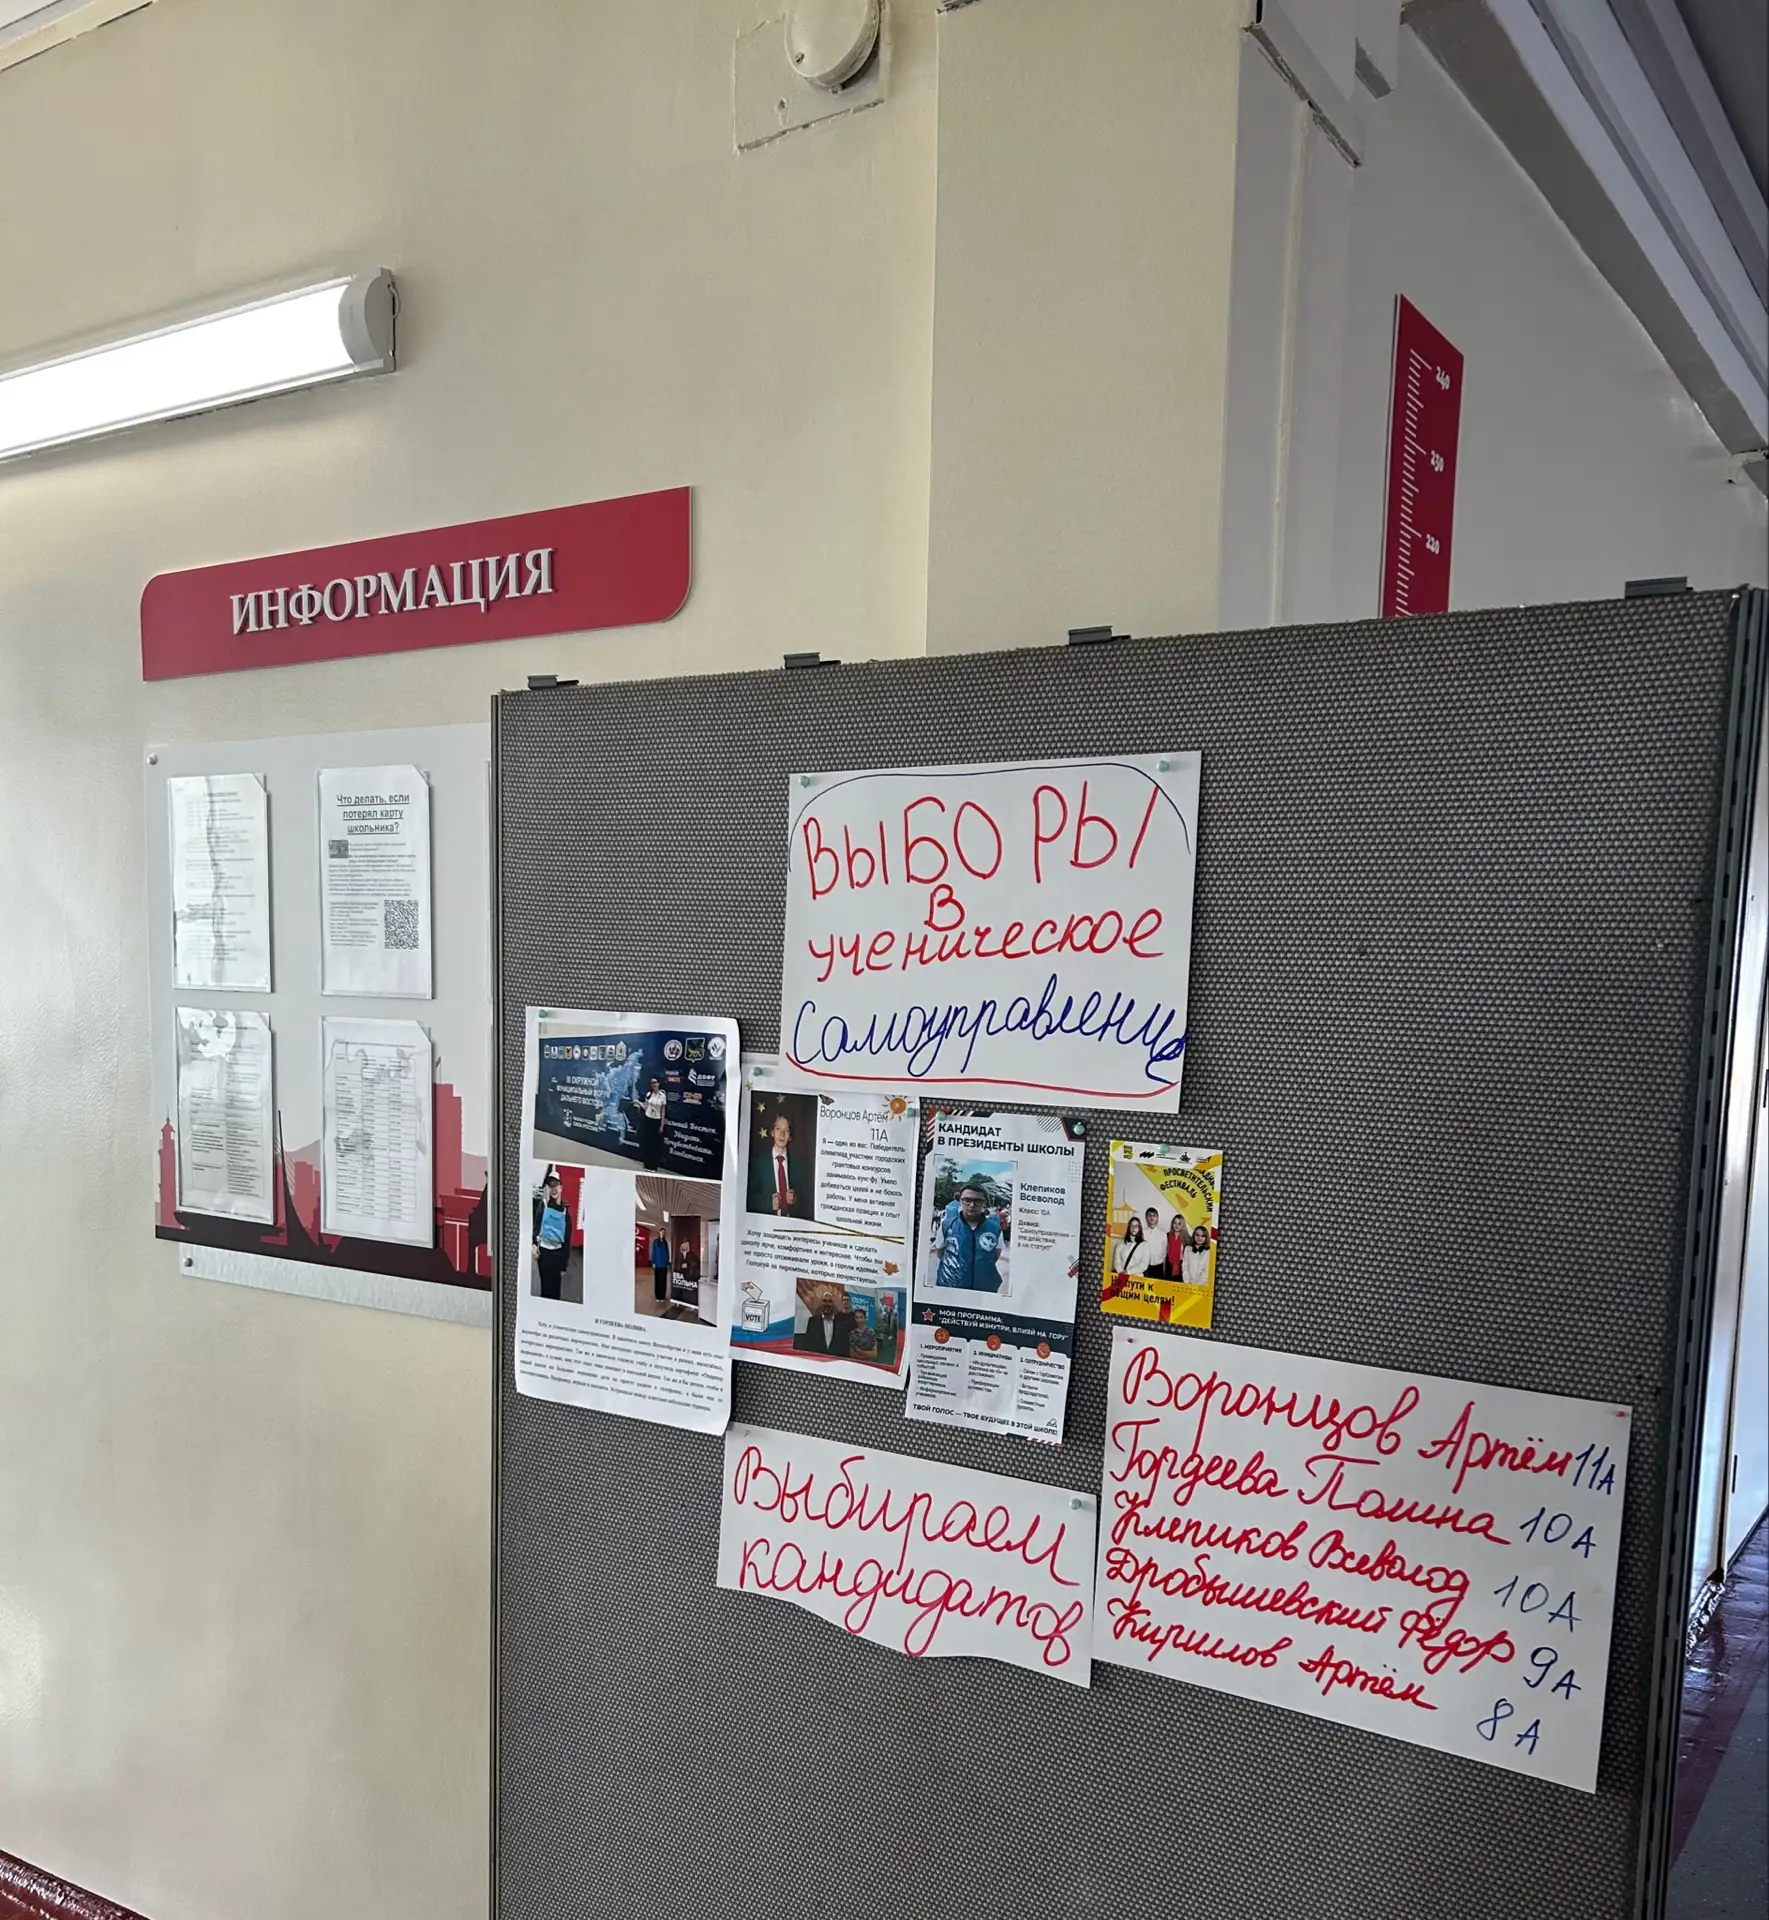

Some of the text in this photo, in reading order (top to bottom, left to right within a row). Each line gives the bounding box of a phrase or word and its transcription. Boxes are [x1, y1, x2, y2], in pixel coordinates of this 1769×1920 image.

[1436, 366, 1450, 390] 240
[1431, 450, 1445, 472] 230
[1425, 533, 1440, 554] 220
[229, 547, 556, 635] ИНФОРМАЦИЯ
[337, 793, 410, 804] Что делать, если
[343, 808, 404, 820] потерял карту
[347, 822, 400, 834] школьника?
[808, 908, 1164, 982] ученическое
[820, 1105, 888, 1124] Воронцов Артём
[870, 1128, 889, 1142] 11А
[938, 1123, 1001, 1137] КАНДИДАТ
[870, 1143, 906, 1153] Победитель
[937, 1136, 1074, 1156] В ПРЕЗИДЕНТЫ ШКОЛЫ
[884, 1189, 903, 1197] боюсь
[1020, 1183, 1066, 1194] Клепиков
[1160, 1180, 1197, 1198] ФЕСТИВАЛЬ
[1020, 1192, 1065, 1205] Всеволод
[1019, 1207, 1039, 1215] Класс:
[747, 1229, 761, 1237] Хочу
[855, 1245, 878, 1253] сделать
[741, 1240, 760, 1248] школу
[854, 1255, 872, 1263] Чтобы
[746, 1259, 769, 1268] Голосуй
[1126, 1280, 1145, 1291] пути
[1144, 1294, 1175, 1306] целям!
[745, 1313, 761, 1322] VOTE
[957, 1311, 1003, 1323] ПРОГРАММА:
[1012, 1326, 1036, 1336] ВЛИЯЙ
[913, 1403, 930, 1411] ТВОЙ
[932, 1406, 954, 1416] ГОЛОС
[963, 1411, 979, 1420] ТВОЕ
[980, 1415, 1010, 1426] БУДУЩЕЕ
[1016, 1421, 1033, 1430] ЭТОЙ
[1034, 1426, 1058, 1436] ШКОЛЕ!
[1123, 1346, 1420, 1462] Воронцов
[1418, 1401, 1575, 1494] Артём
[1109, 1418, 1289, 1506] Гордеева
[1297, 1454, 1511, 1546] Полина
[734, 1446, 1081, 1586] Выбираем
[1111, 1489, 1308, 1562] Клепиков
[1308, 1529, 1471, 1622] Всеволод
[1106, 1547, 1393, 1634] Дробышевский
[739, 1537, 1085, 1667] кандидатов
[1107, 1598, 1293, 1669] Кириллов
[1298, 1645, 1438, 1711] Артём
